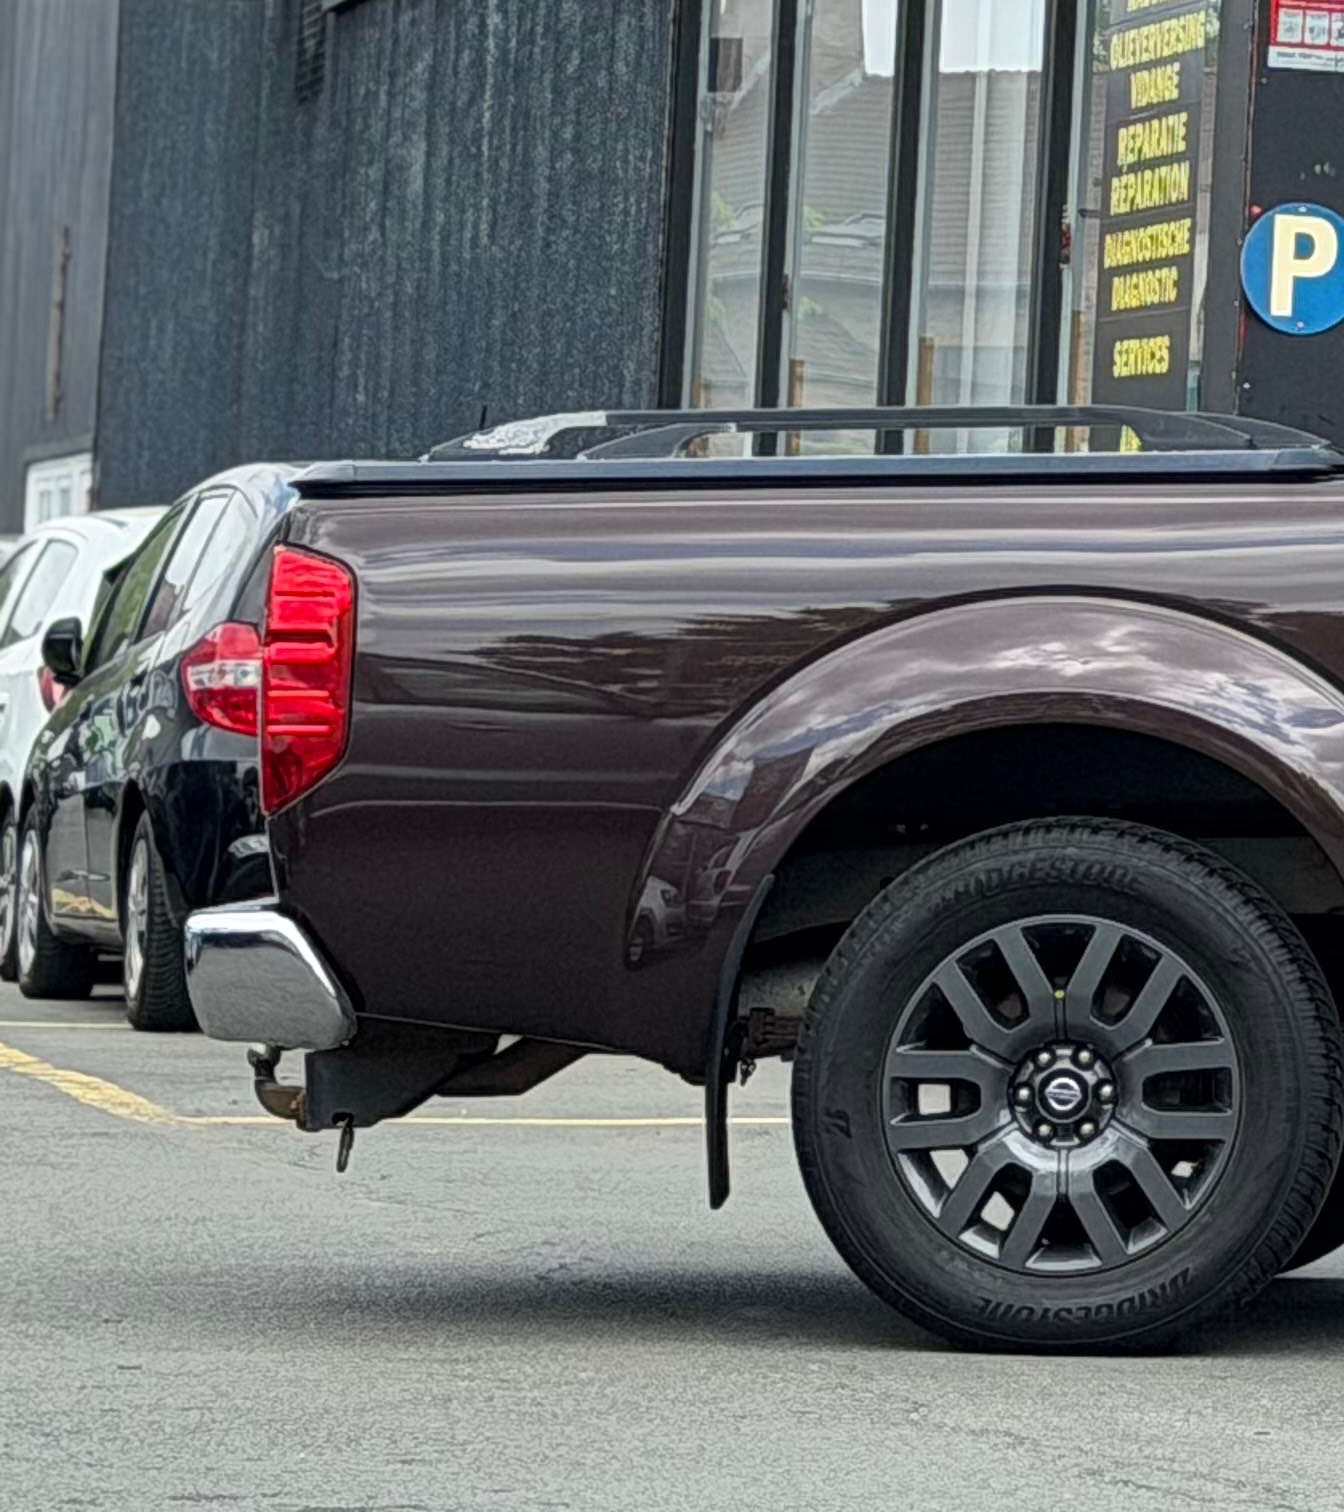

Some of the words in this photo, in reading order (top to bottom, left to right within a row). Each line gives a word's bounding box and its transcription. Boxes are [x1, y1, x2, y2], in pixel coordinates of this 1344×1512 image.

[1111, 265, 1178, 312] DIAGNOSTIC
[1270, 214, 1339, 317] P
[1112, 335, 1171, 378] SERVICES
